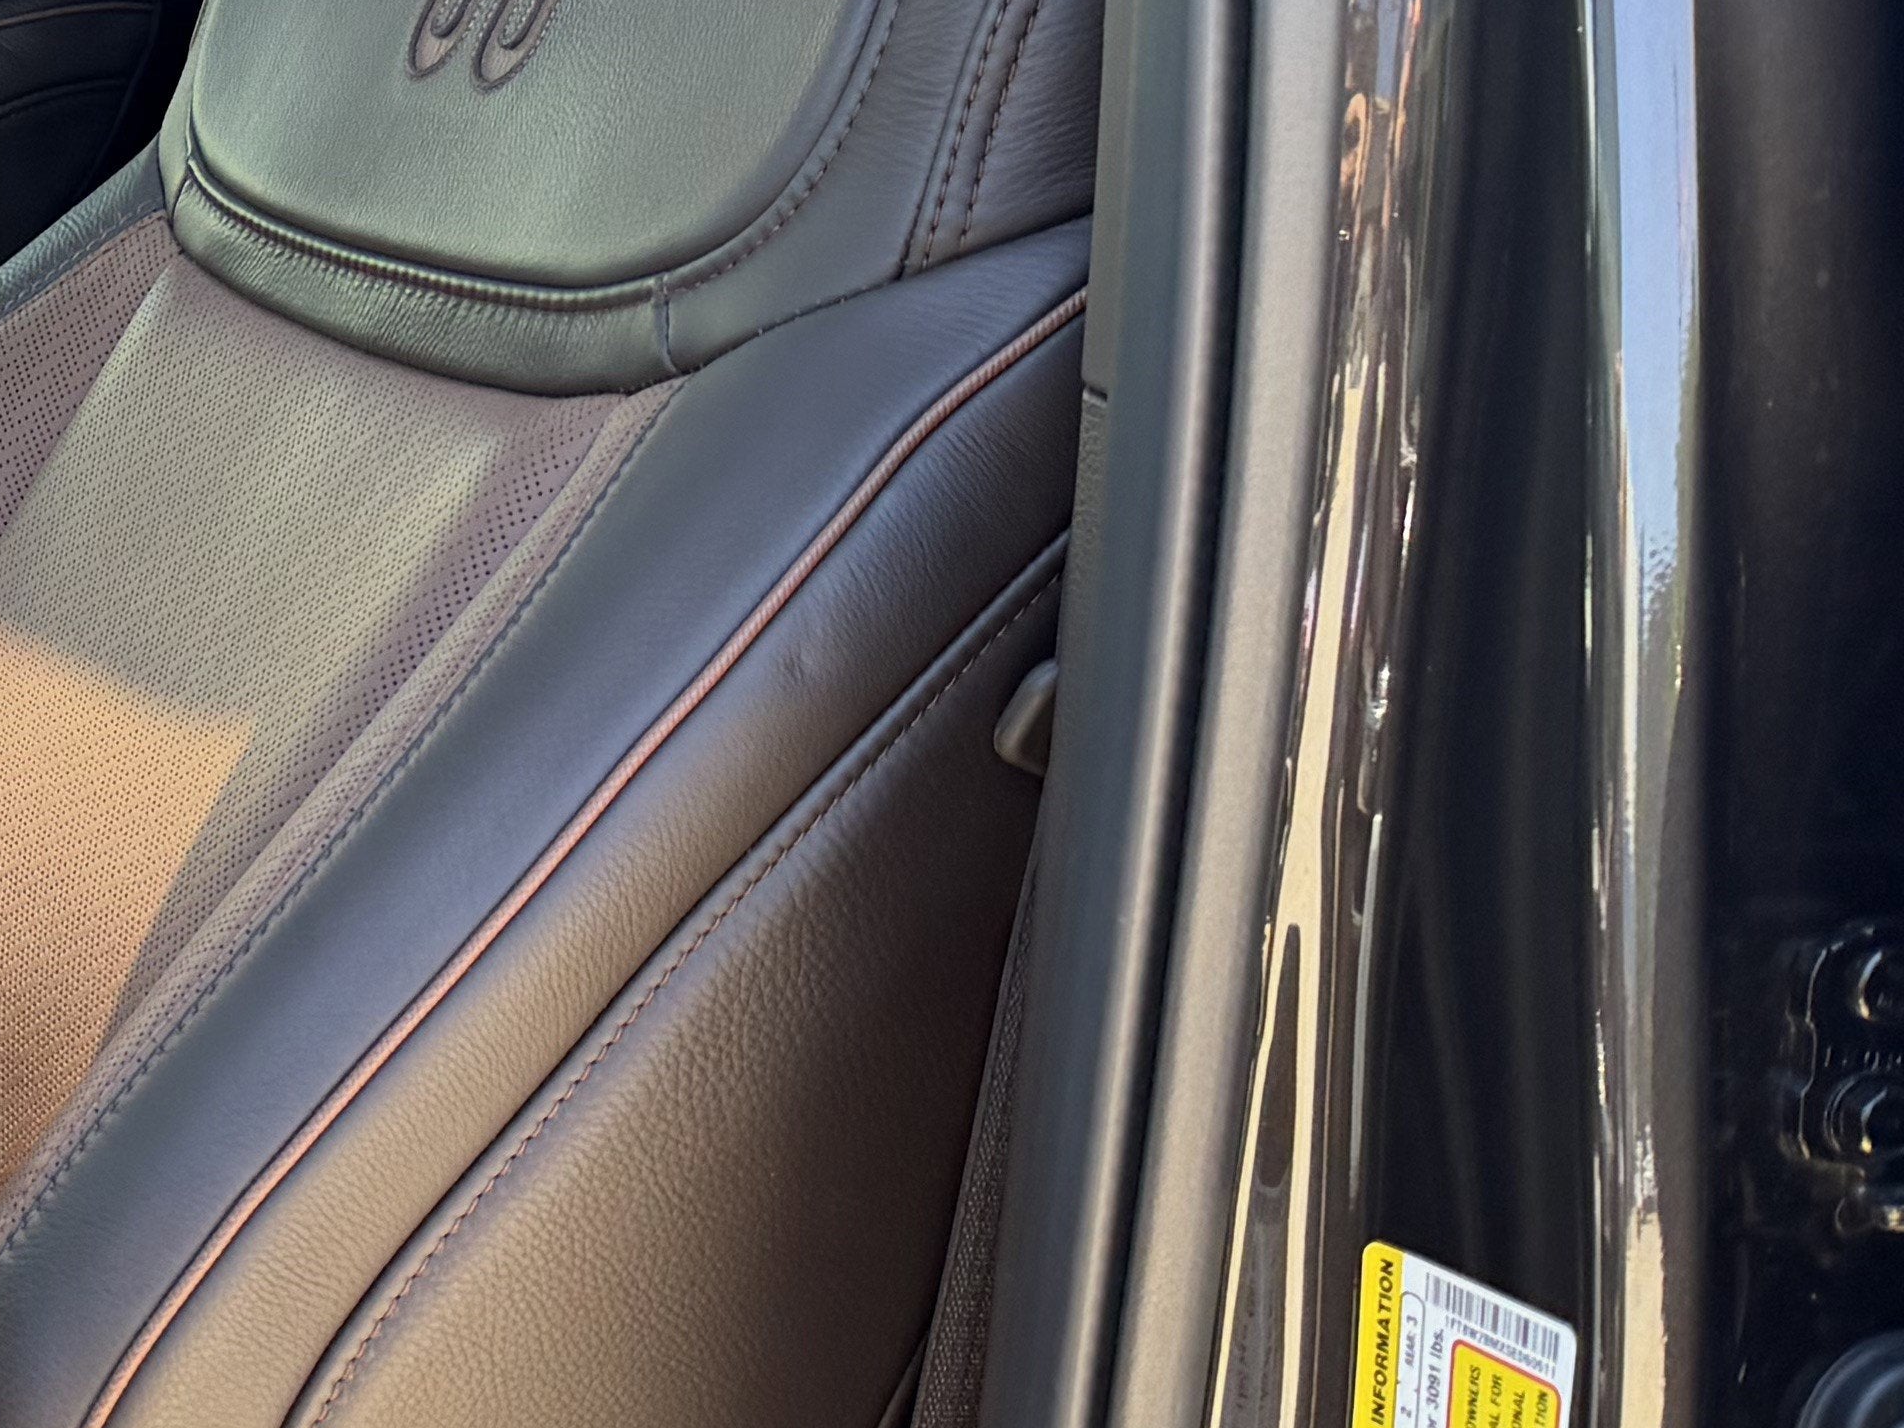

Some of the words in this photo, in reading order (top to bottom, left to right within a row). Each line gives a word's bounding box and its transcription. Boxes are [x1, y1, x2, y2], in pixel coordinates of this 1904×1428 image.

[1406, 1314, 1418, 1326] 3
[1371, 1258, 1394, 1425] INFORMATION
[1429, 1328, 1444, 1360] lbs.
[1426, 1364, 1440, 1410] 3091
[1490, 1374, 1502, 1407] FOR
[1400, 1406, 1411, 1418] 2
